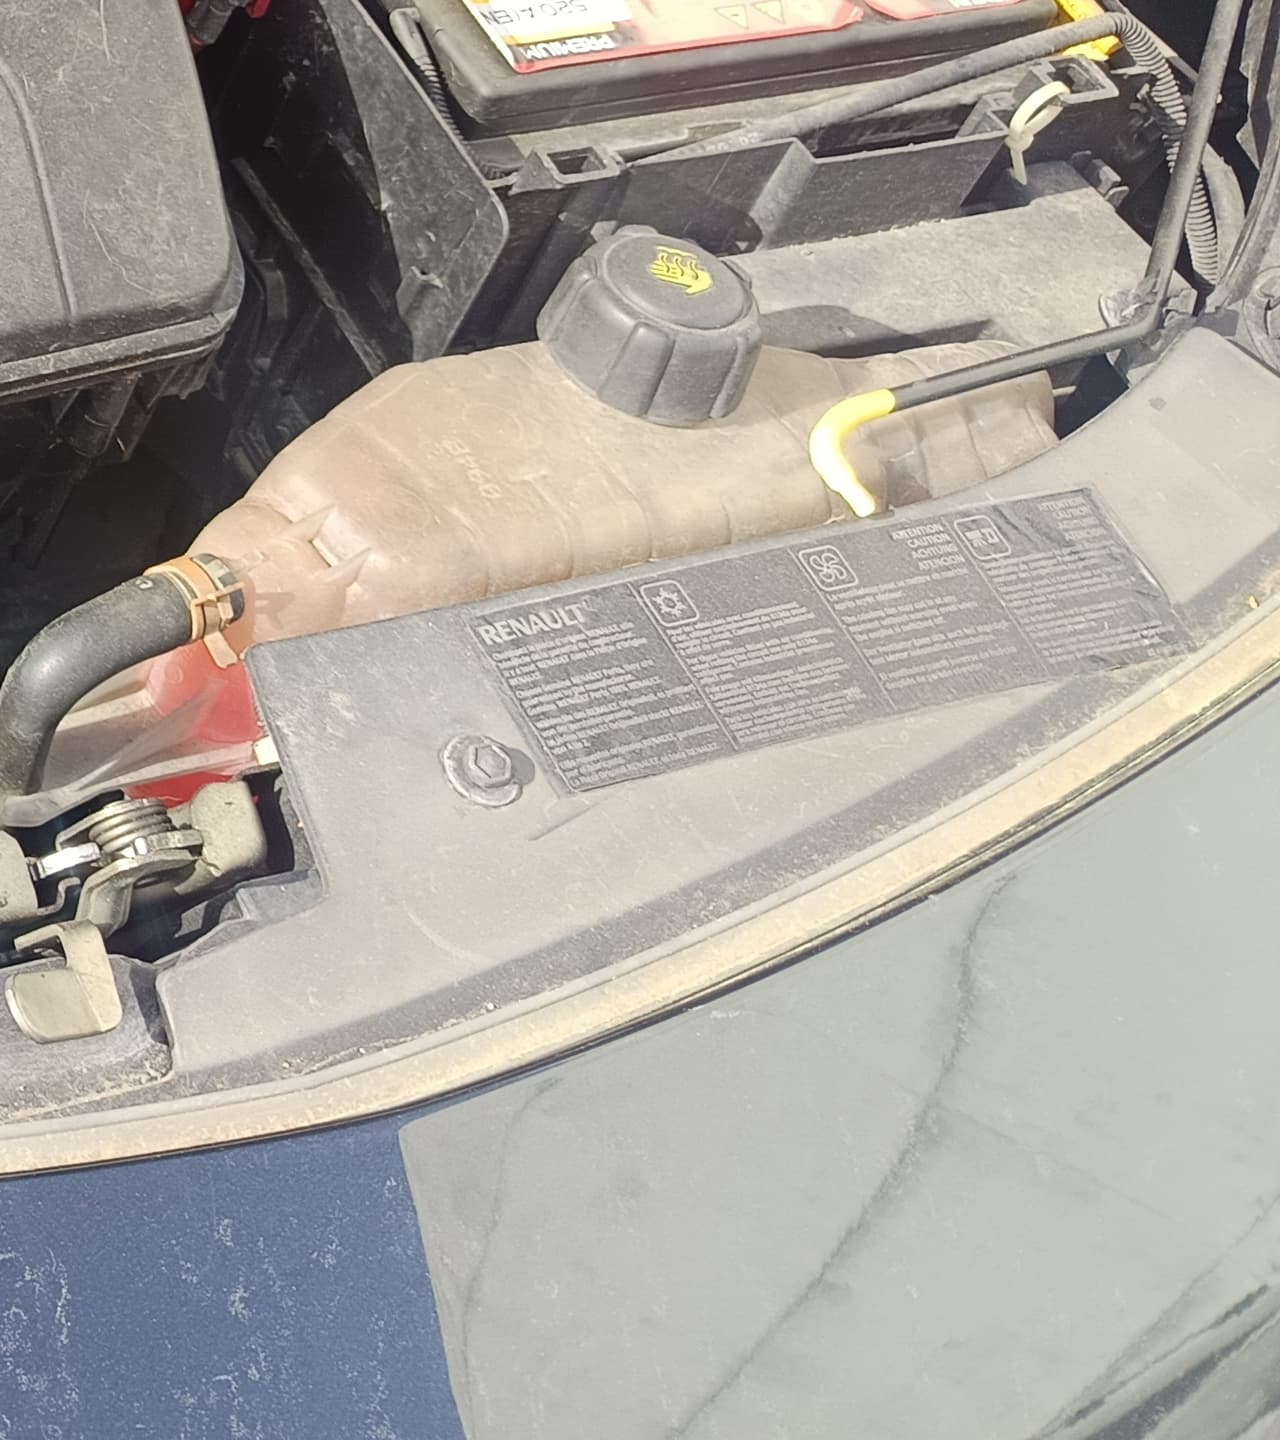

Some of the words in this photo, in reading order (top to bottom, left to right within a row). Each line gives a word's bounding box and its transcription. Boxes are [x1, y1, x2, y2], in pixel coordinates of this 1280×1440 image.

[521, 34, 617, 60] PREMIUM
[907, 532, 950, 547] CAUTION
[479, 604, 585, 645] RENAULT
